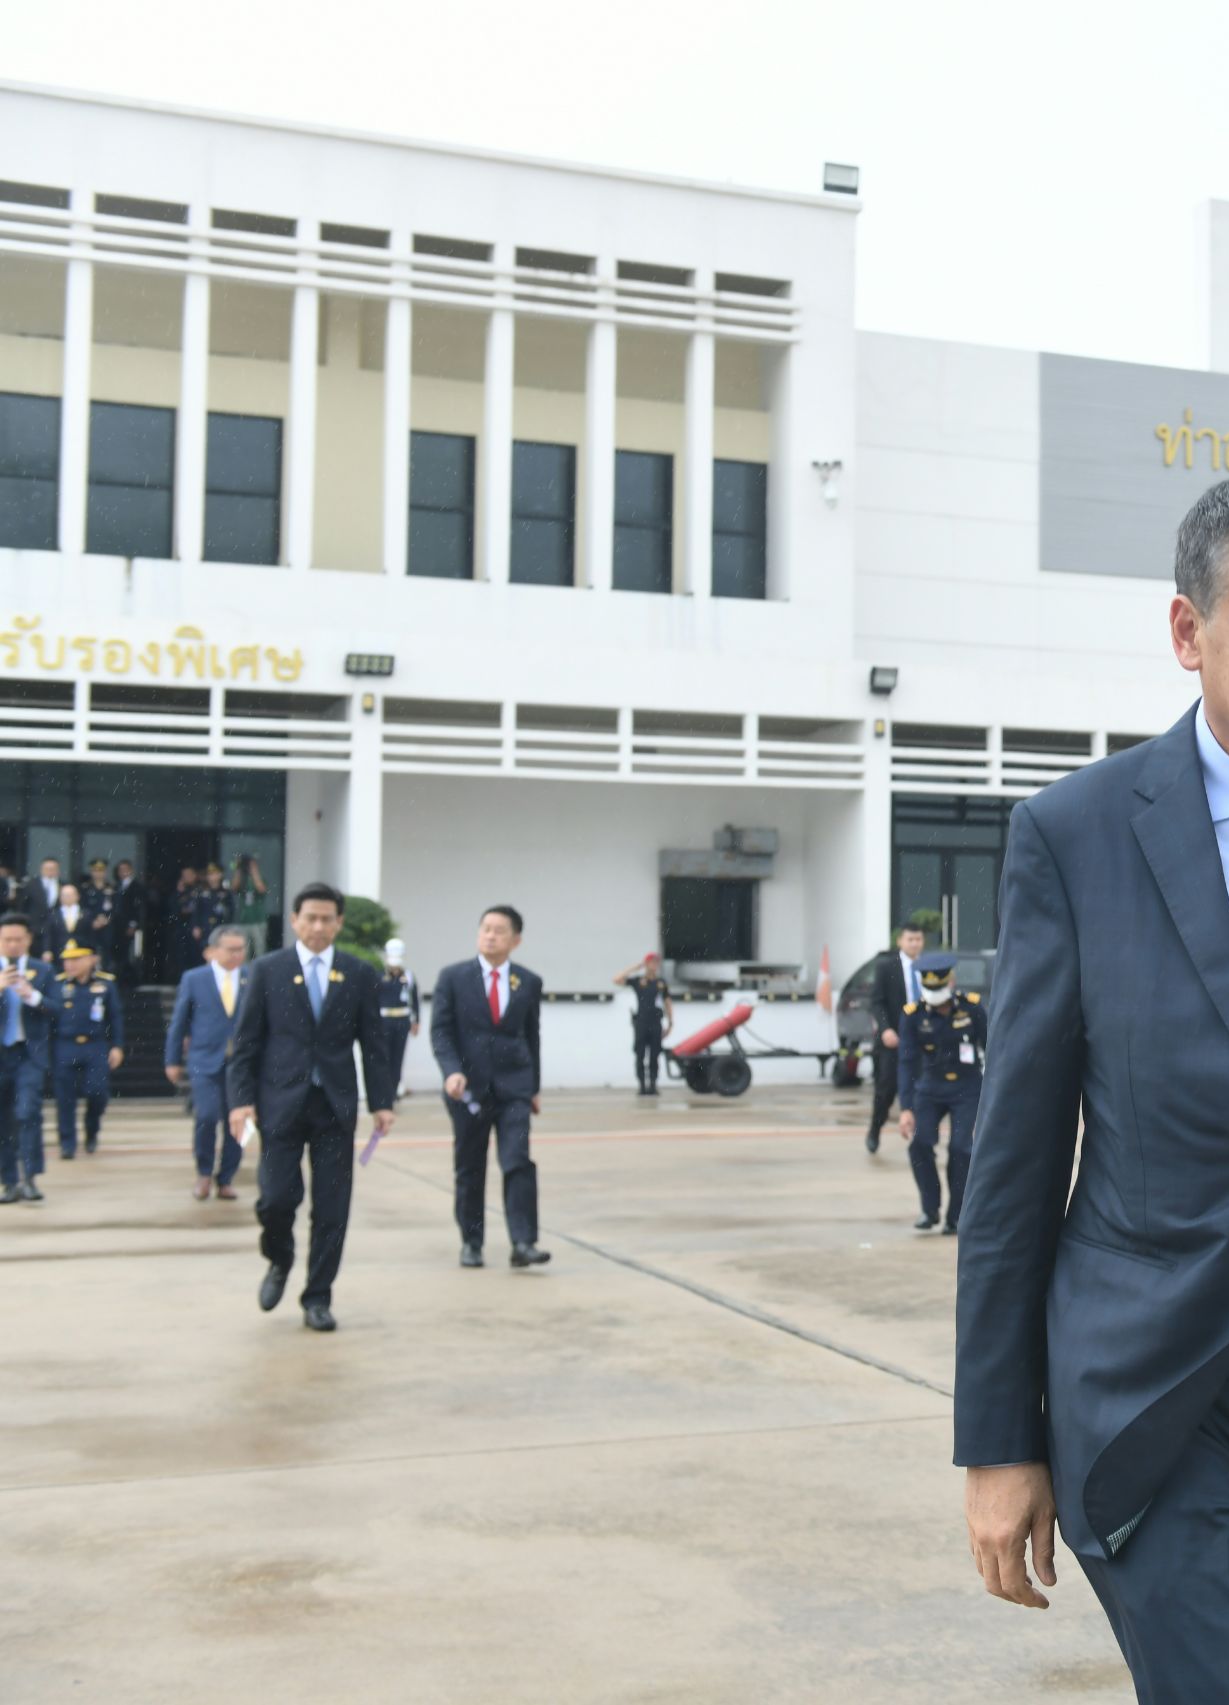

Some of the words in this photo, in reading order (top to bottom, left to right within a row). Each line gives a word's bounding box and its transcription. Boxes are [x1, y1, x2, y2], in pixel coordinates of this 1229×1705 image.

[0, 615, 304, 682] รับรองพิเศษ
